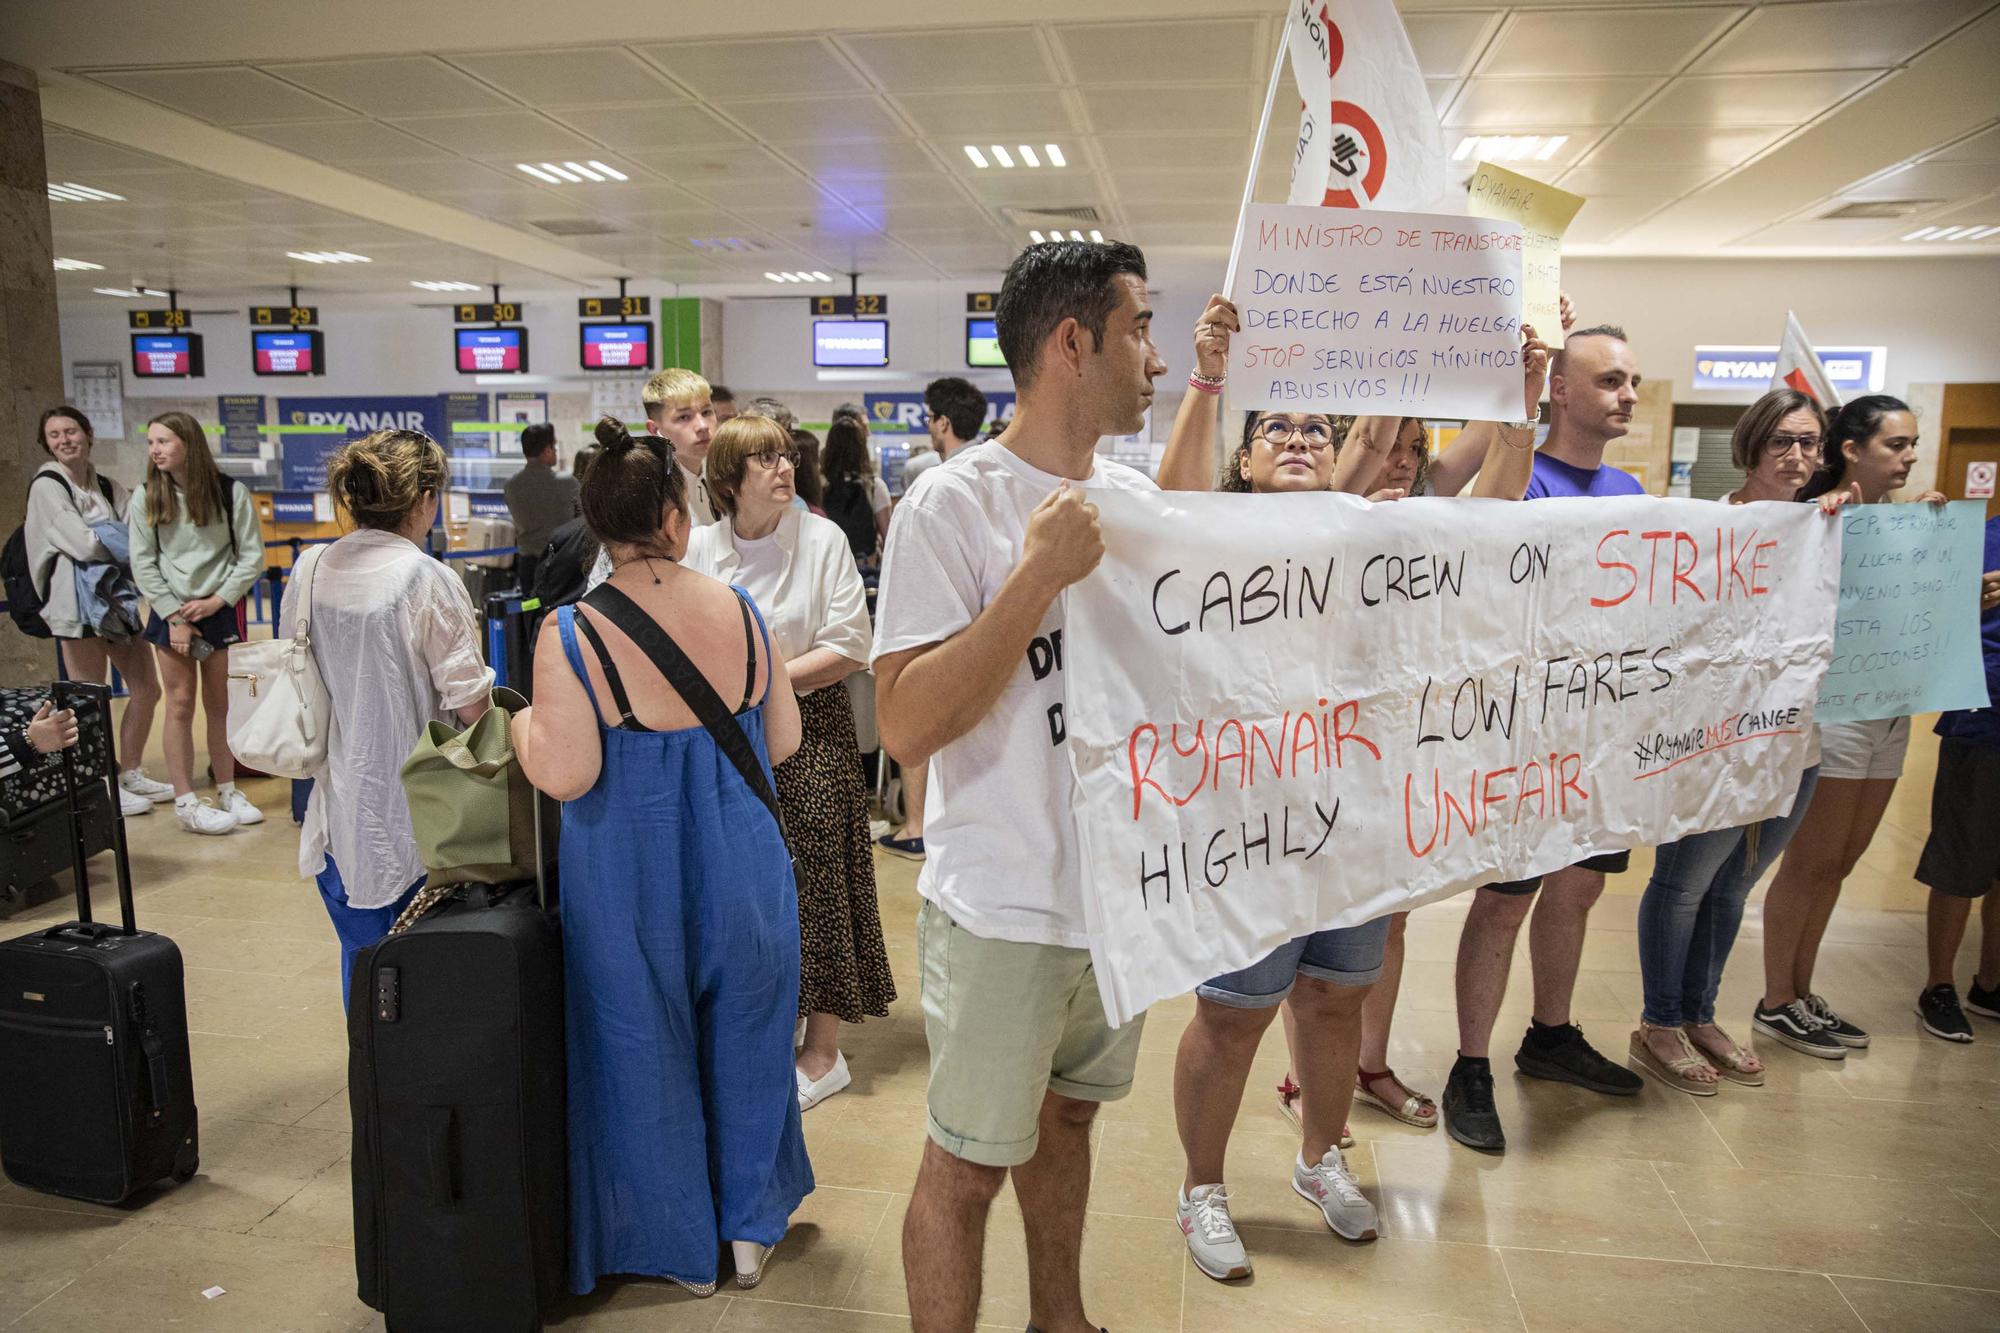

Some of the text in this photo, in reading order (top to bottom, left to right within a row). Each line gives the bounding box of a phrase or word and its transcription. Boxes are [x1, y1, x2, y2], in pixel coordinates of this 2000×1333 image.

[1301, 2, 1328, 60] NIÓN
[1396, 230, 1421, 248] DE
[1432, 231, 1521, 252] TRANSPORTE
[1252, 267, 1514, 297] DONDE ESTÁ NUESTRO
[493, 304, 514, 321] 30
[622, 298, 641, 315] 31
[856, 296, 878, 312] 32
[165, 312, 185, 326] 28
[289, 308, 311, 324] 29
[1247, 309, 1359, 330] DERECHO
[1374, 311, 1389, 329] A
[1403, 313, 1428, 333] LA
[1244, 344, 1305, 369] STOP
[1712, 361, 1776, 378] RYAN
[308, 411, 425, 431] RYANAIR
[1361, 550, 1465, 607] CREW
[1510, 542, 1551, 585] ON
[1590, 528, 1777, 607] STRIKE
[1840, 584, 1901, 600] NVENIO
[1899, 611, 1932, 636] LOS
[1417, 664, 1519, 748] LOW
[1542, 646, 1672, 724] FARES
[1141, 797, 1339, 910] HIGHLY
